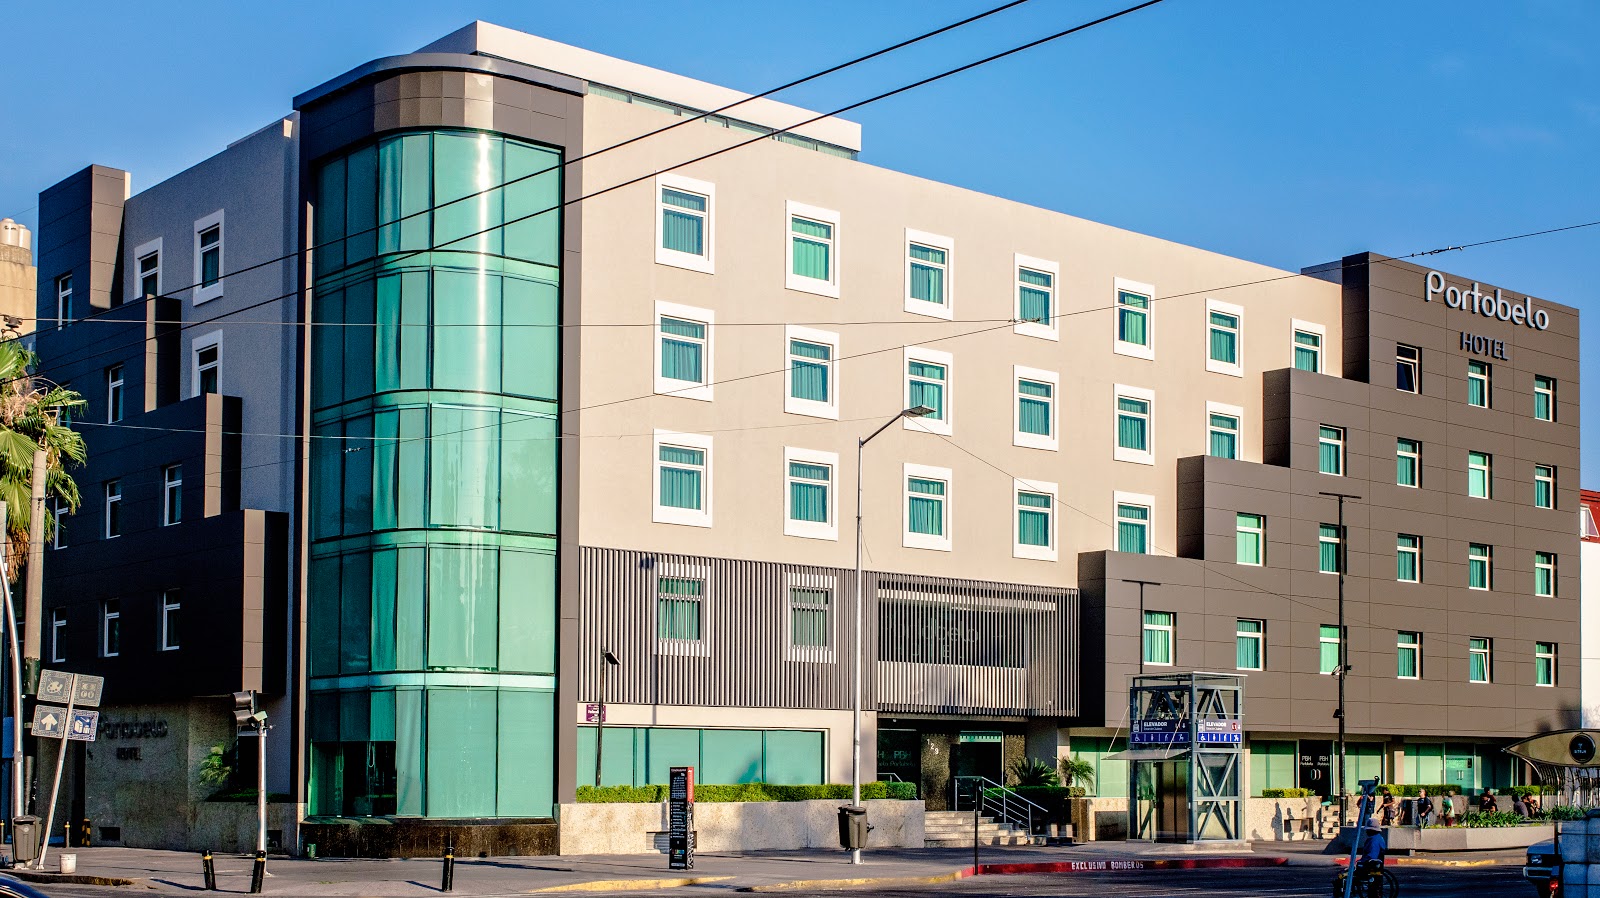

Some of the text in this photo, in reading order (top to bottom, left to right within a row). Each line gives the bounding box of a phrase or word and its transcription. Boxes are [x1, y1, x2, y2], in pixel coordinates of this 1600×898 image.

[1425, 271, 1550, 330] Portobelo
[1460, 331, 1510, 360] HOTEL
[926, 738, 939, 755] 129
[1071, 860, 1144, 870] EXCLUSIVO BOMBEROS
